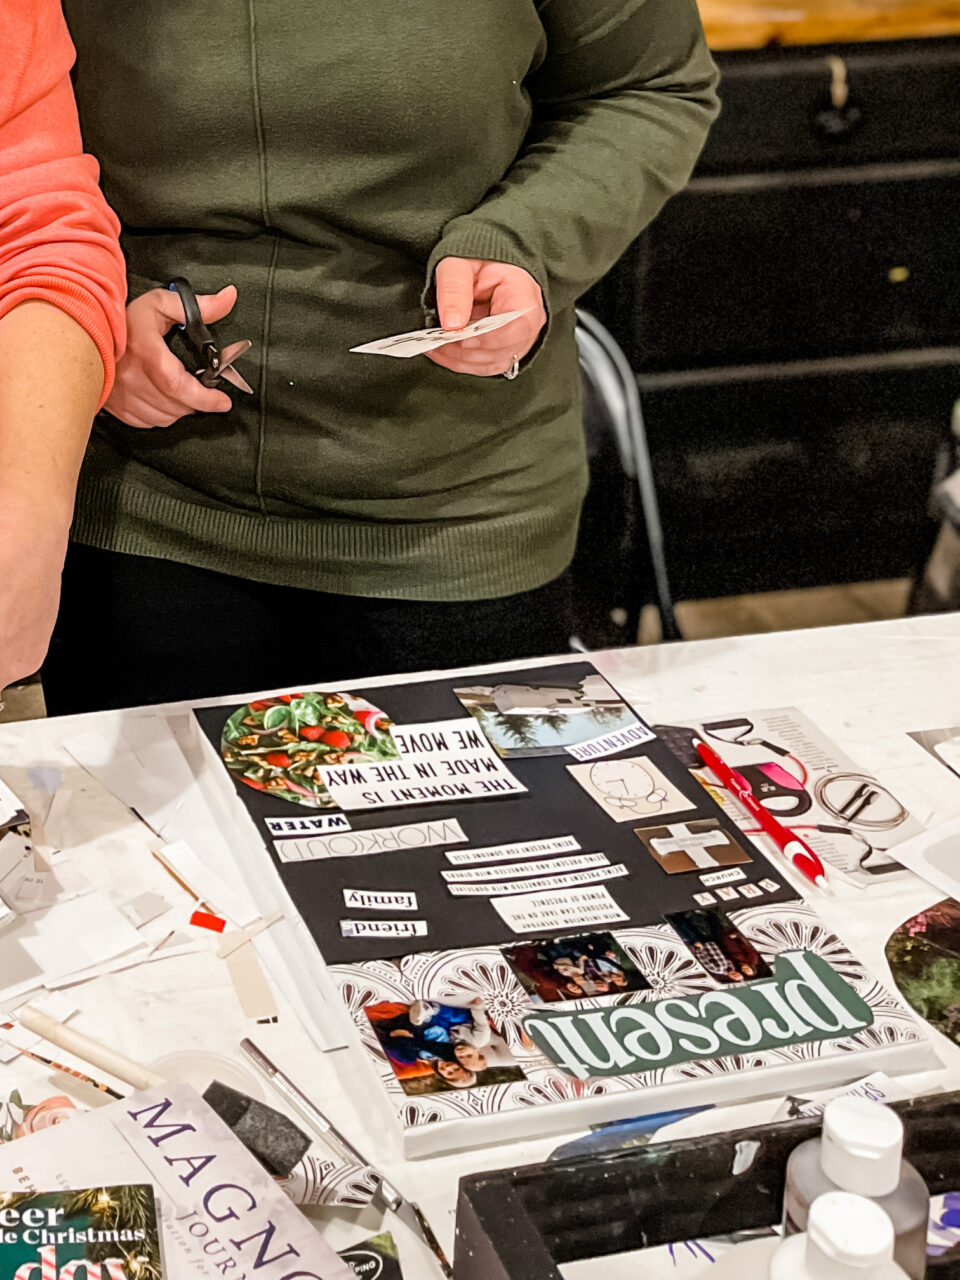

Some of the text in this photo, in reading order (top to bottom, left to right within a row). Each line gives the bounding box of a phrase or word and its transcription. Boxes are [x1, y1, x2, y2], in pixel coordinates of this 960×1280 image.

[394, 729, 484, 754] WE MOVE
[570, 726, 650, 759] ADVENTURE
[325, 756, 499, 787] MADE IN THE WAY
[361, 778, 518, 804] THE MOMENT IS
[268, 816, 347, 831] WATER
[280, 822, 461, 860] WORK(OUT)
[452, 839, 574, 862] BEING PRESENT FOR SOMEONE ELSE
[445, 854, 606, 880] BEING PRESENT AND CONNECTED WITH OTHERS
[702, 870, 740, 884] CHURCH
[448, 866, 624, 893] BEING PRESENT AND CONNECTED WITH OURSELVES
[348, 891, 413, 908] family
[530, 891, 606, 908] POWER OF PRESENCE
[697, 882, 775, 903] PRAY
[510, 902, 614, 922] POSTURES CAN TAKE ON THE
[603, 912, 621, 922] WITH
[521, 919, 560, 930] EVERYDAY
[523, 950, 867, 1080] present
[127, 1098, 323, 1280] MAGN
[22, 1227, 147, 1244] Christmas
[175, 1210, 248, 1280] JOUR
